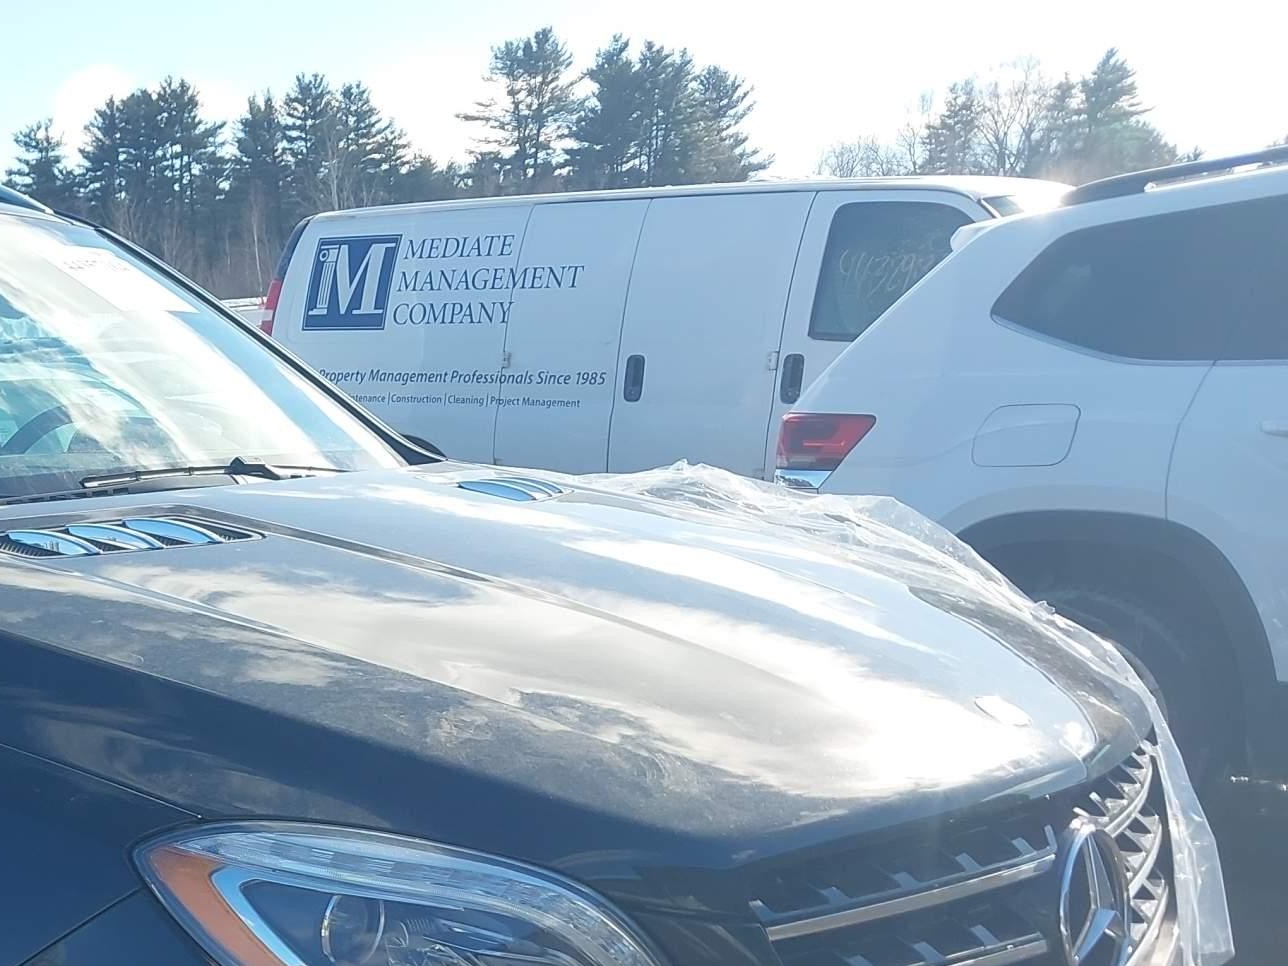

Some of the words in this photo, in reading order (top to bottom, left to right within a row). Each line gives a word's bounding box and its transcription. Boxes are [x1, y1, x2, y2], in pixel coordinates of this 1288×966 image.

[404, 234, 515, 259] MEDIATE
[396, 265, 585, 292] MANAGEMENT
[393, 301, 515, 325] COMPANY
[368, 369, 447, 385] Management
[450, 370, 533, 385] Professionals
[536, 370, 571, 385] Since
[576, 371, 607, 385] 1985
[391, 393, 442, 404] Construction
[447, 394, 484, 407] Cleaning
[490, 395, 520, 408] Project
[522, 396, 580, 408] Management
